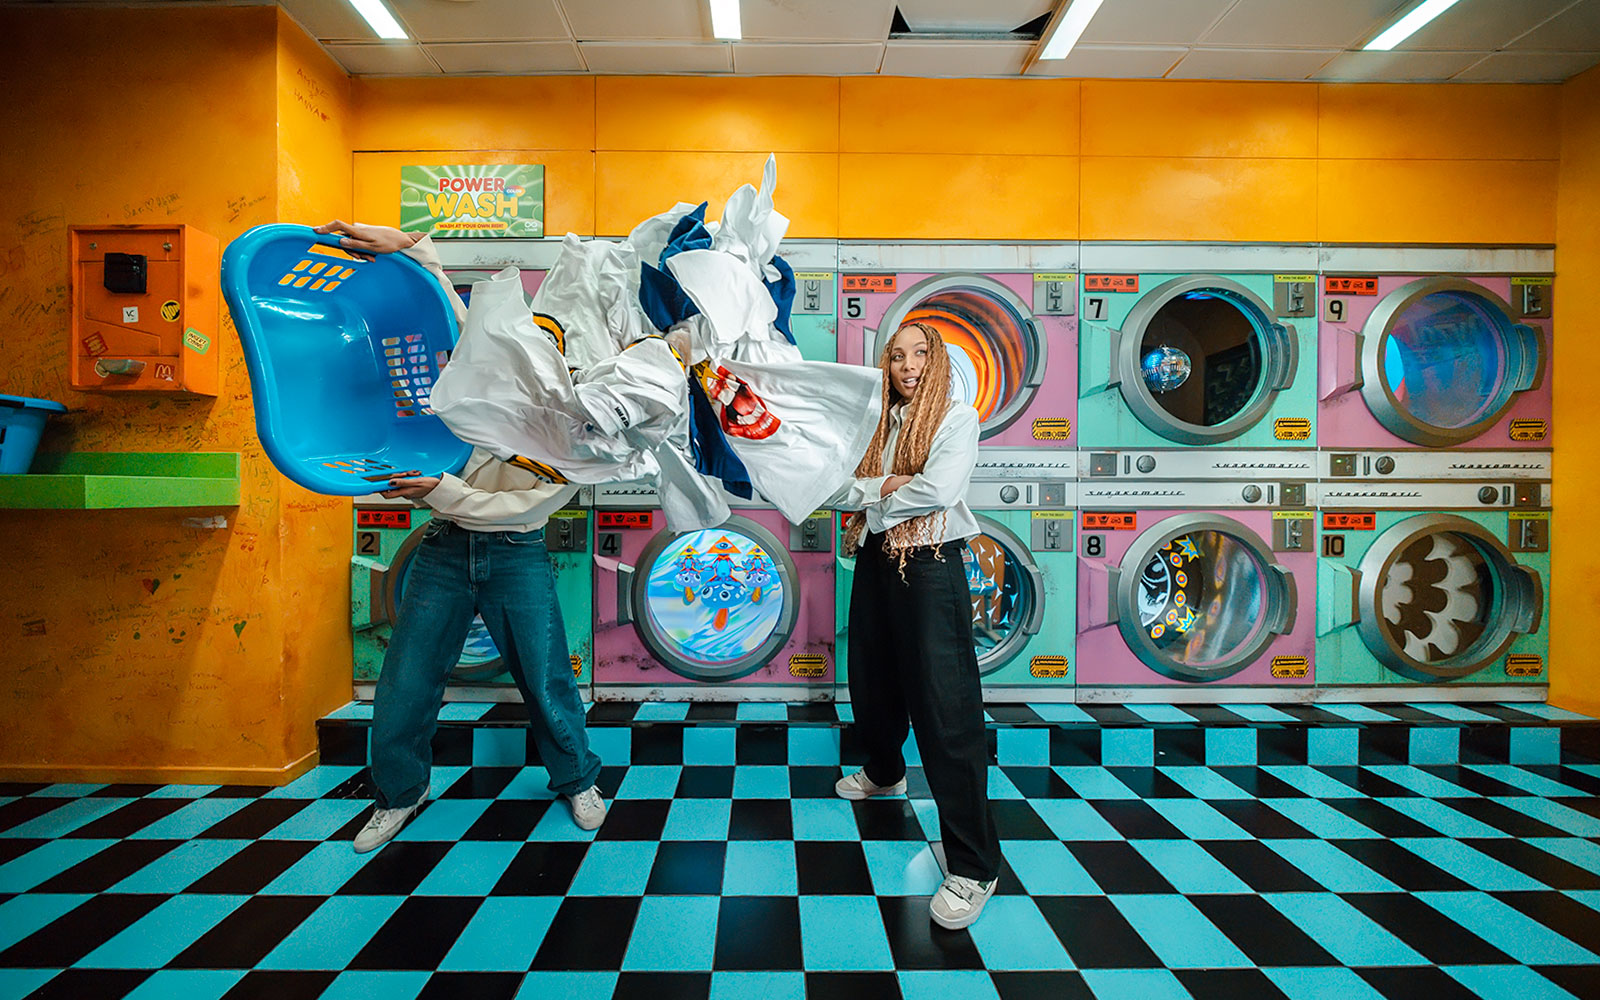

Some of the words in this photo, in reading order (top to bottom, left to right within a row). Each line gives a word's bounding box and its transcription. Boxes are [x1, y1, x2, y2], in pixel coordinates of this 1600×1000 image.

[439, 177, 505, 192] POWER
[425, 192, 518, 218] WASH
[847, 298, 861, 317] 5
[1089, 299, 1103, 318] 7
[1329, 300, 1343, 320] 9
[361, 533, 374, 553] 2
[602, 534, 617, 554] 4
[1087, 536, 1101, 556] 8
[1323, 536, 1344, 556] 10
